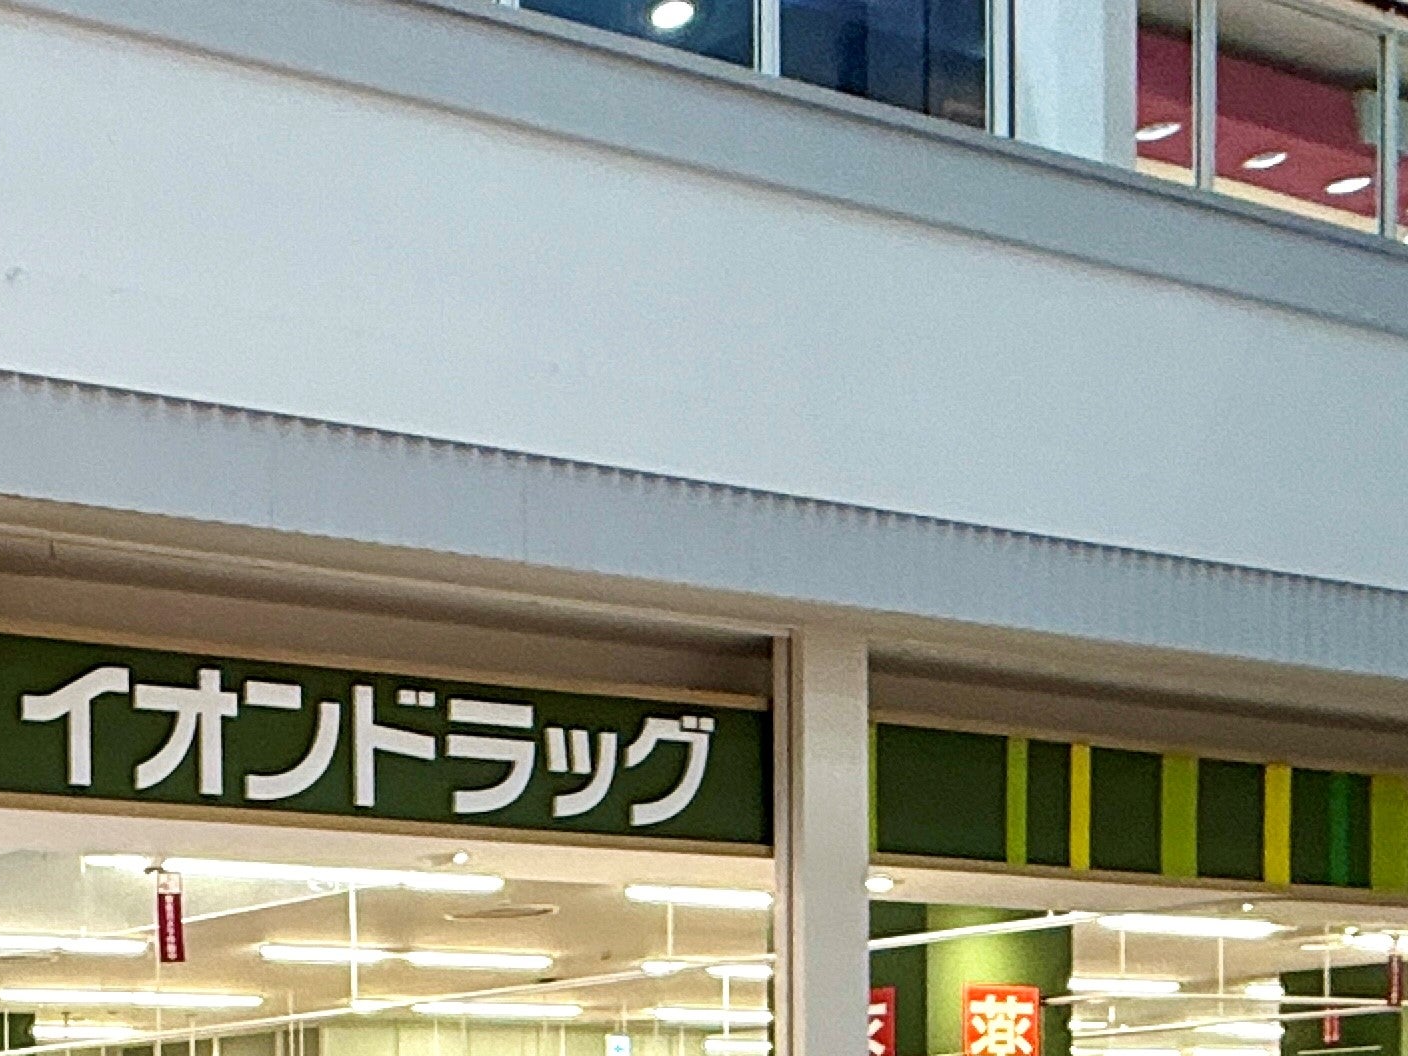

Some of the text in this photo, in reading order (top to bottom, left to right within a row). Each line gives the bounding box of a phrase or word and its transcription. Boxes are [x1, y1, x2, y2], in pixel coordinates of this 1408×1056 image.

[21, 667, 715, 827] イオンドラッグ
